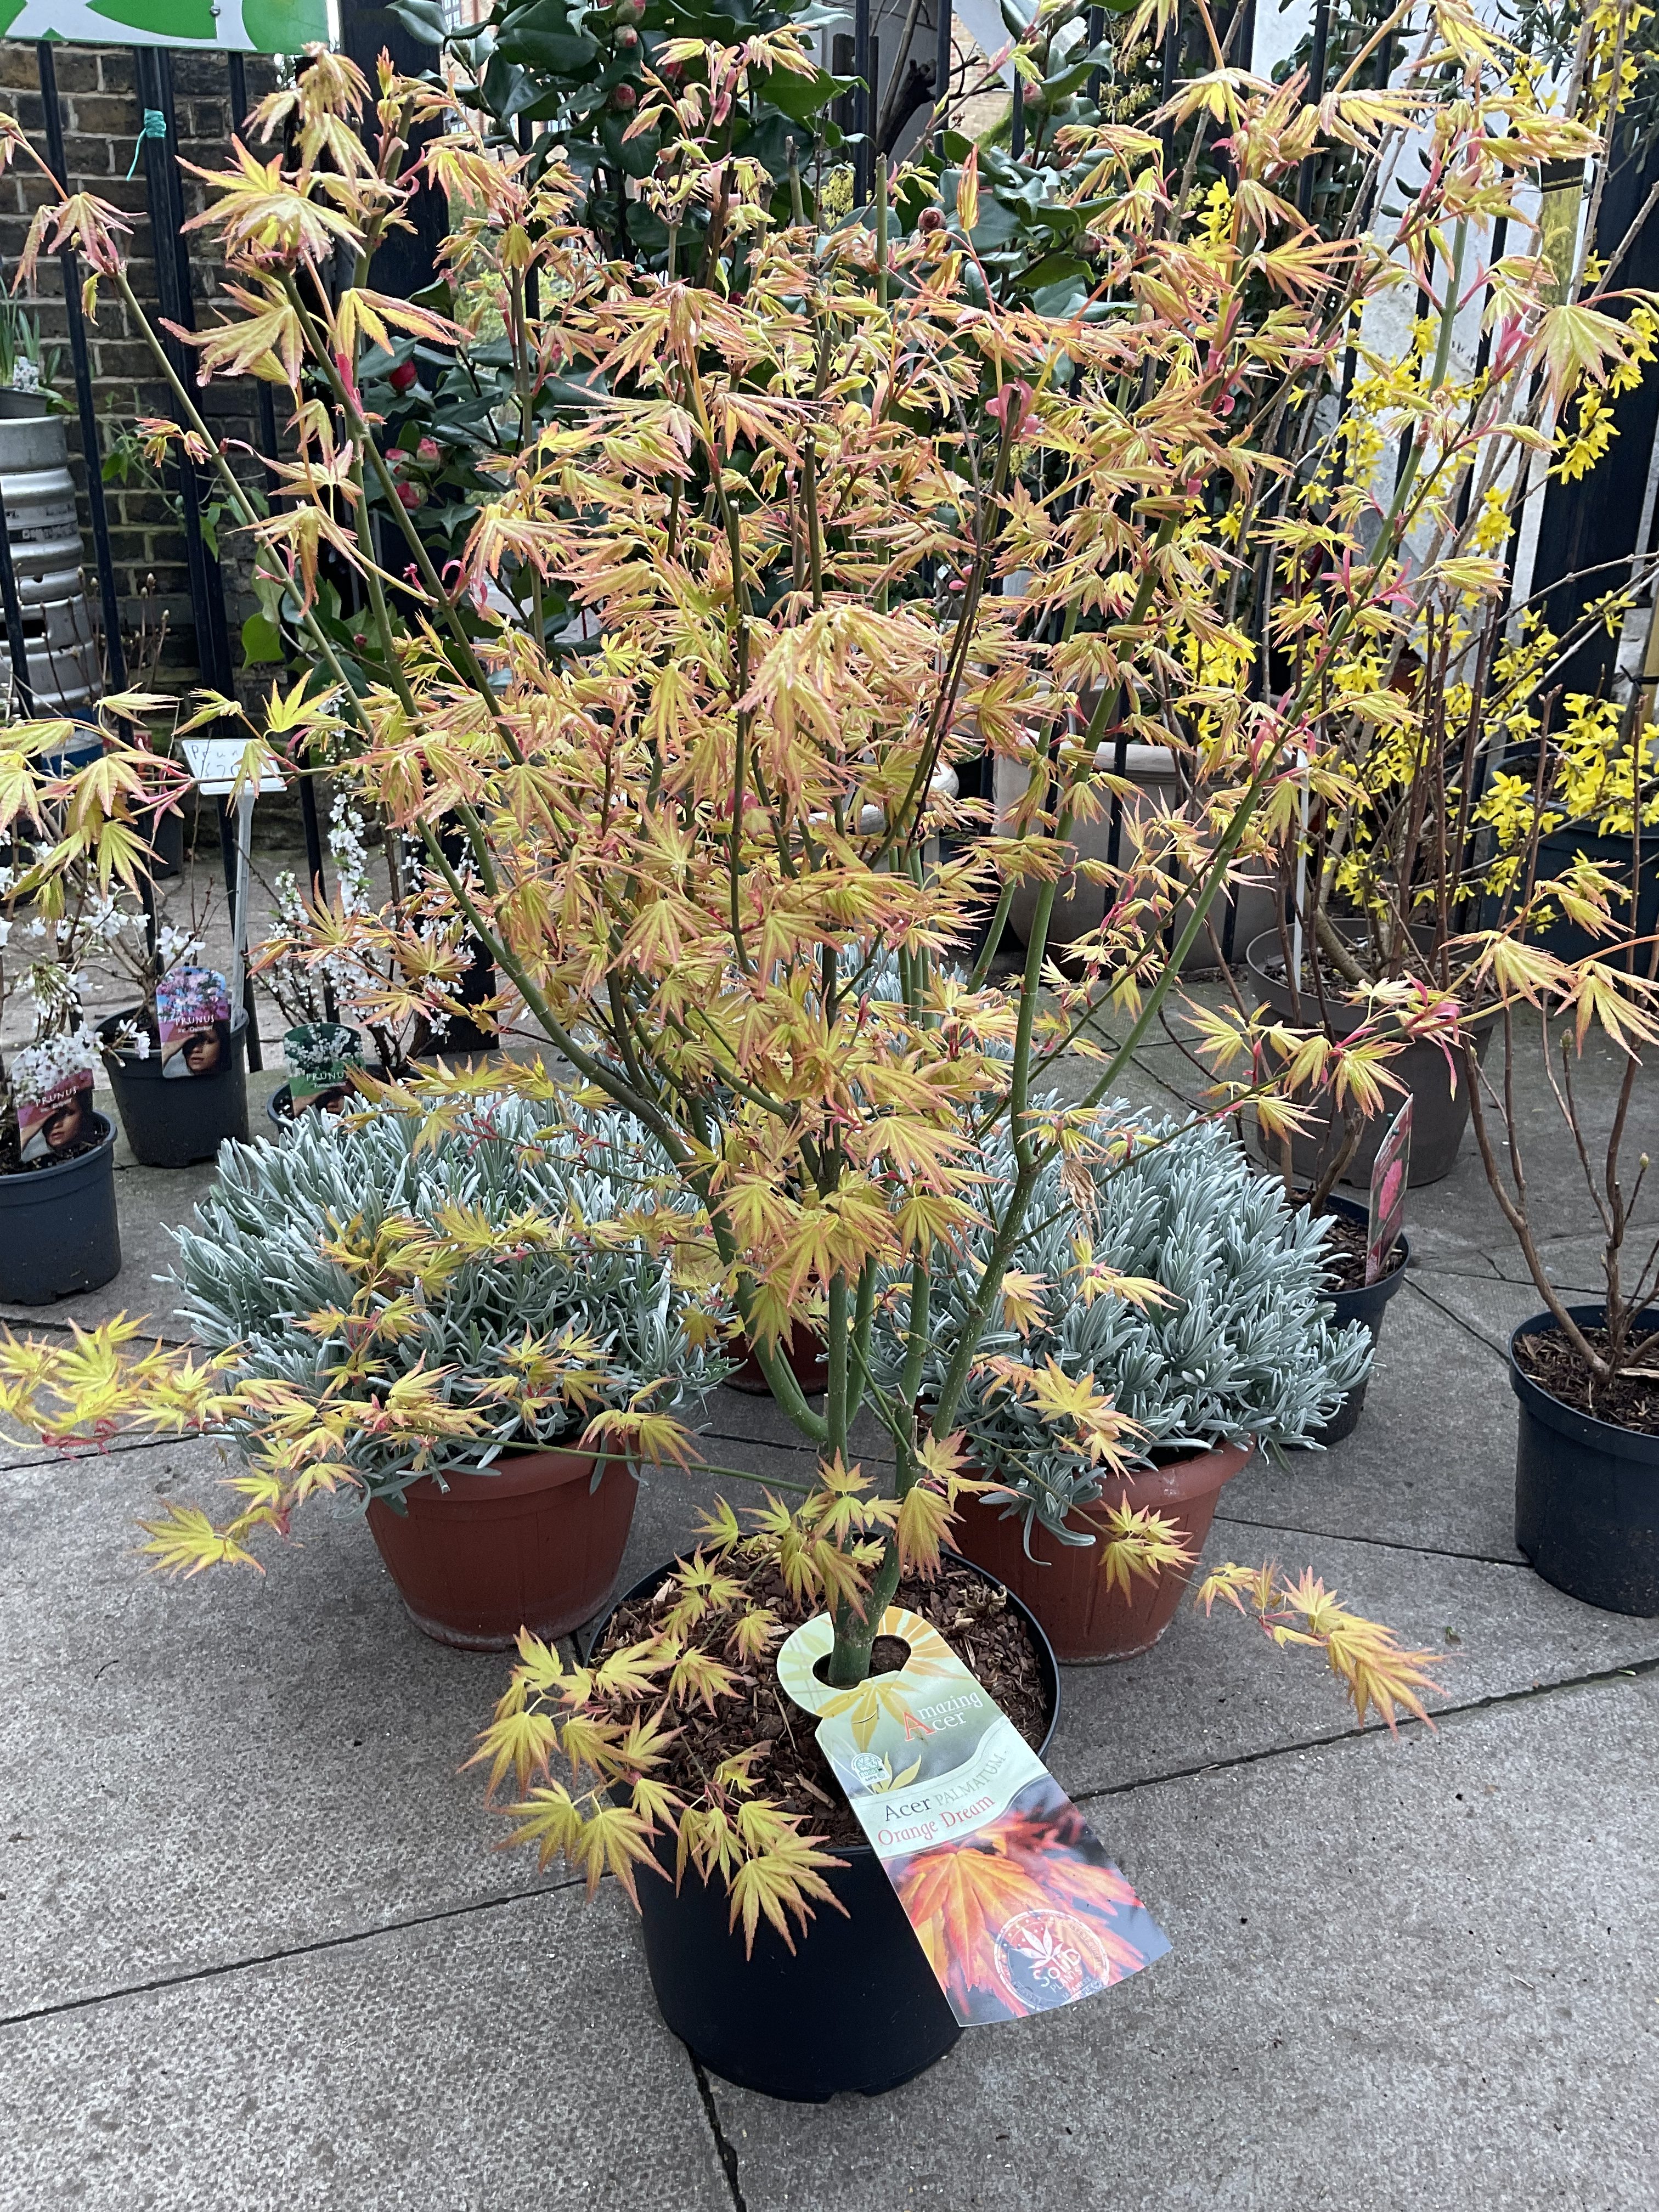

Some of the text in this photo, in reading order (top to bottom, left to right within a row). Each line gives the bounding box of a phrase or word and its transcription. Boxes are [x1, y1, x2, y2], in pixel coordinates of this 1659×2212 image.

[176, 1014, 215, 1026] PRUNUS
[306, 1071, 345, 1081] PRUNU
[35, 1085, 79, 1107] PRUNUS
[885, 1753, 1007, 1821] Acer PALMATUM
[878, 1796, 996, 1846] Orange Dream
[1049, 1965, 1083, 1993] PLANTS
